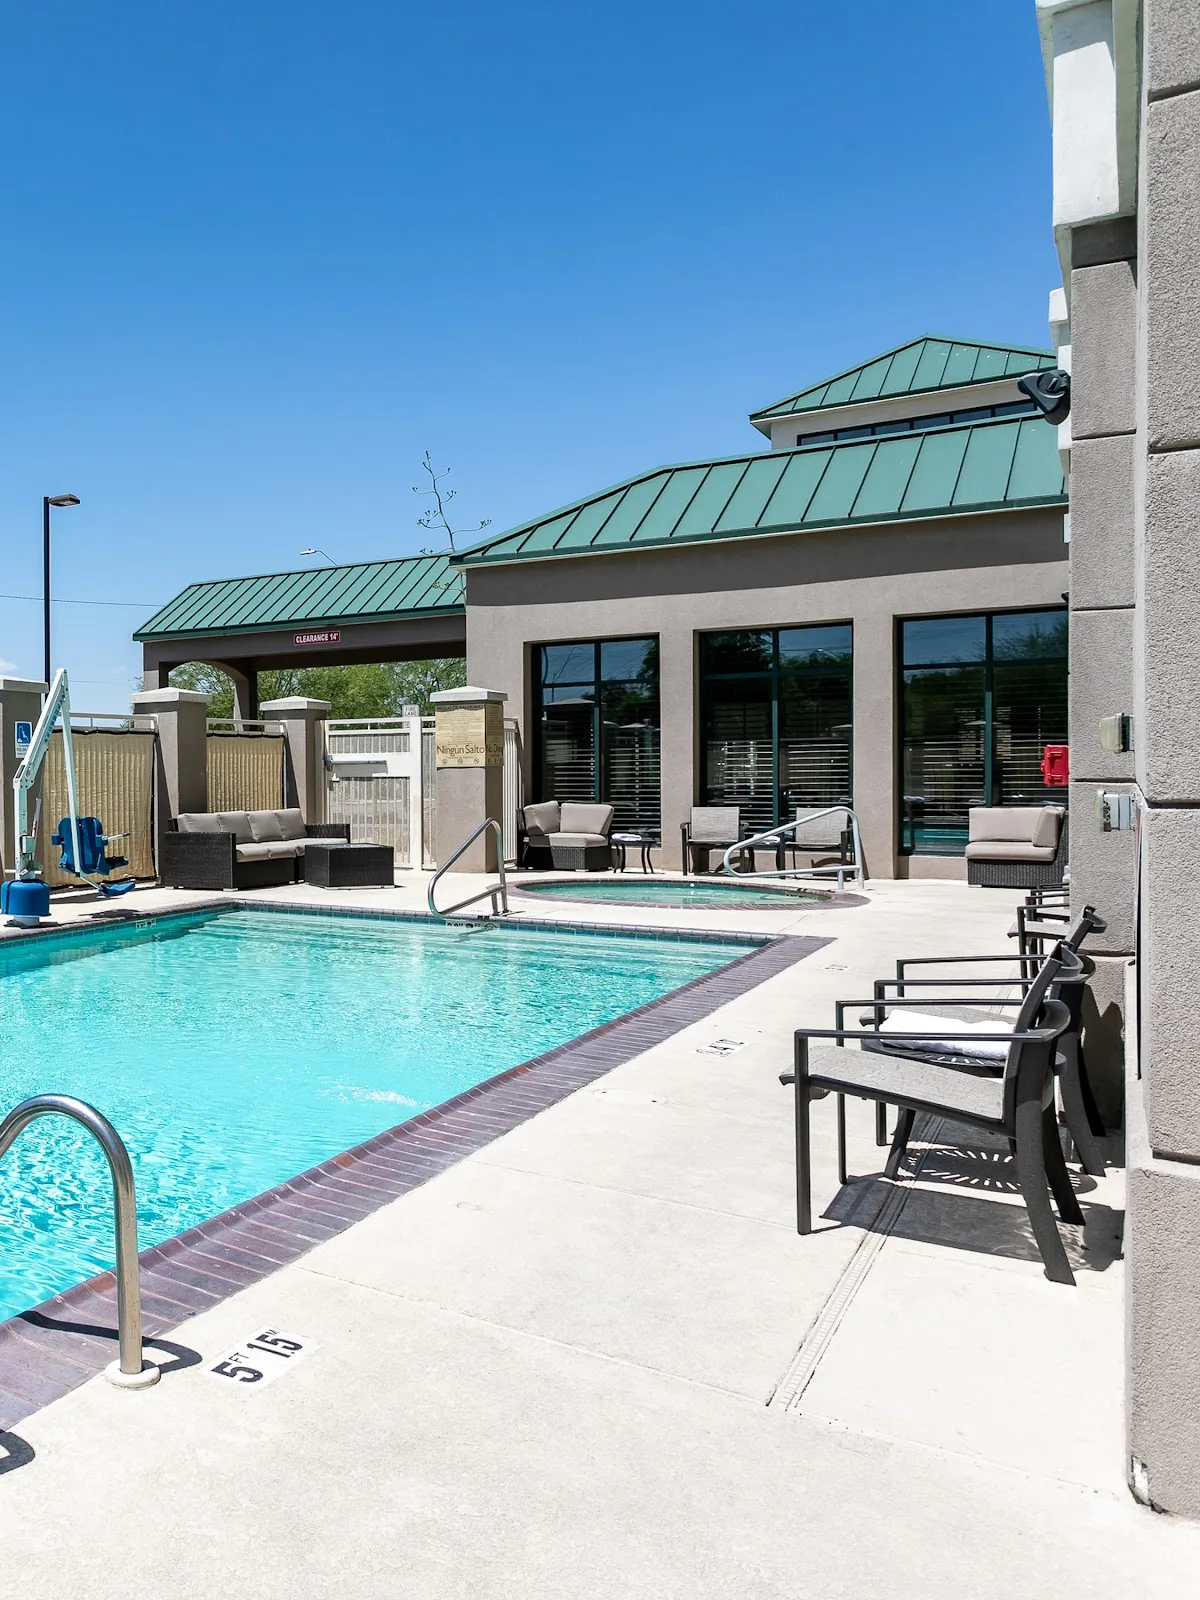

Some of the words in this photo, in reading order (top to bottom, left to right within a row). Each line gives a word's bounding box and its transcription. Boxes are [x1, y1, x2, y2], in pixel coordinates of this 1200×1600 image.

[295, 633, 329, 644] CLEARANCE
[436, 744, 464, 757] Ningún
[465, 744, 485, 754] Salto
